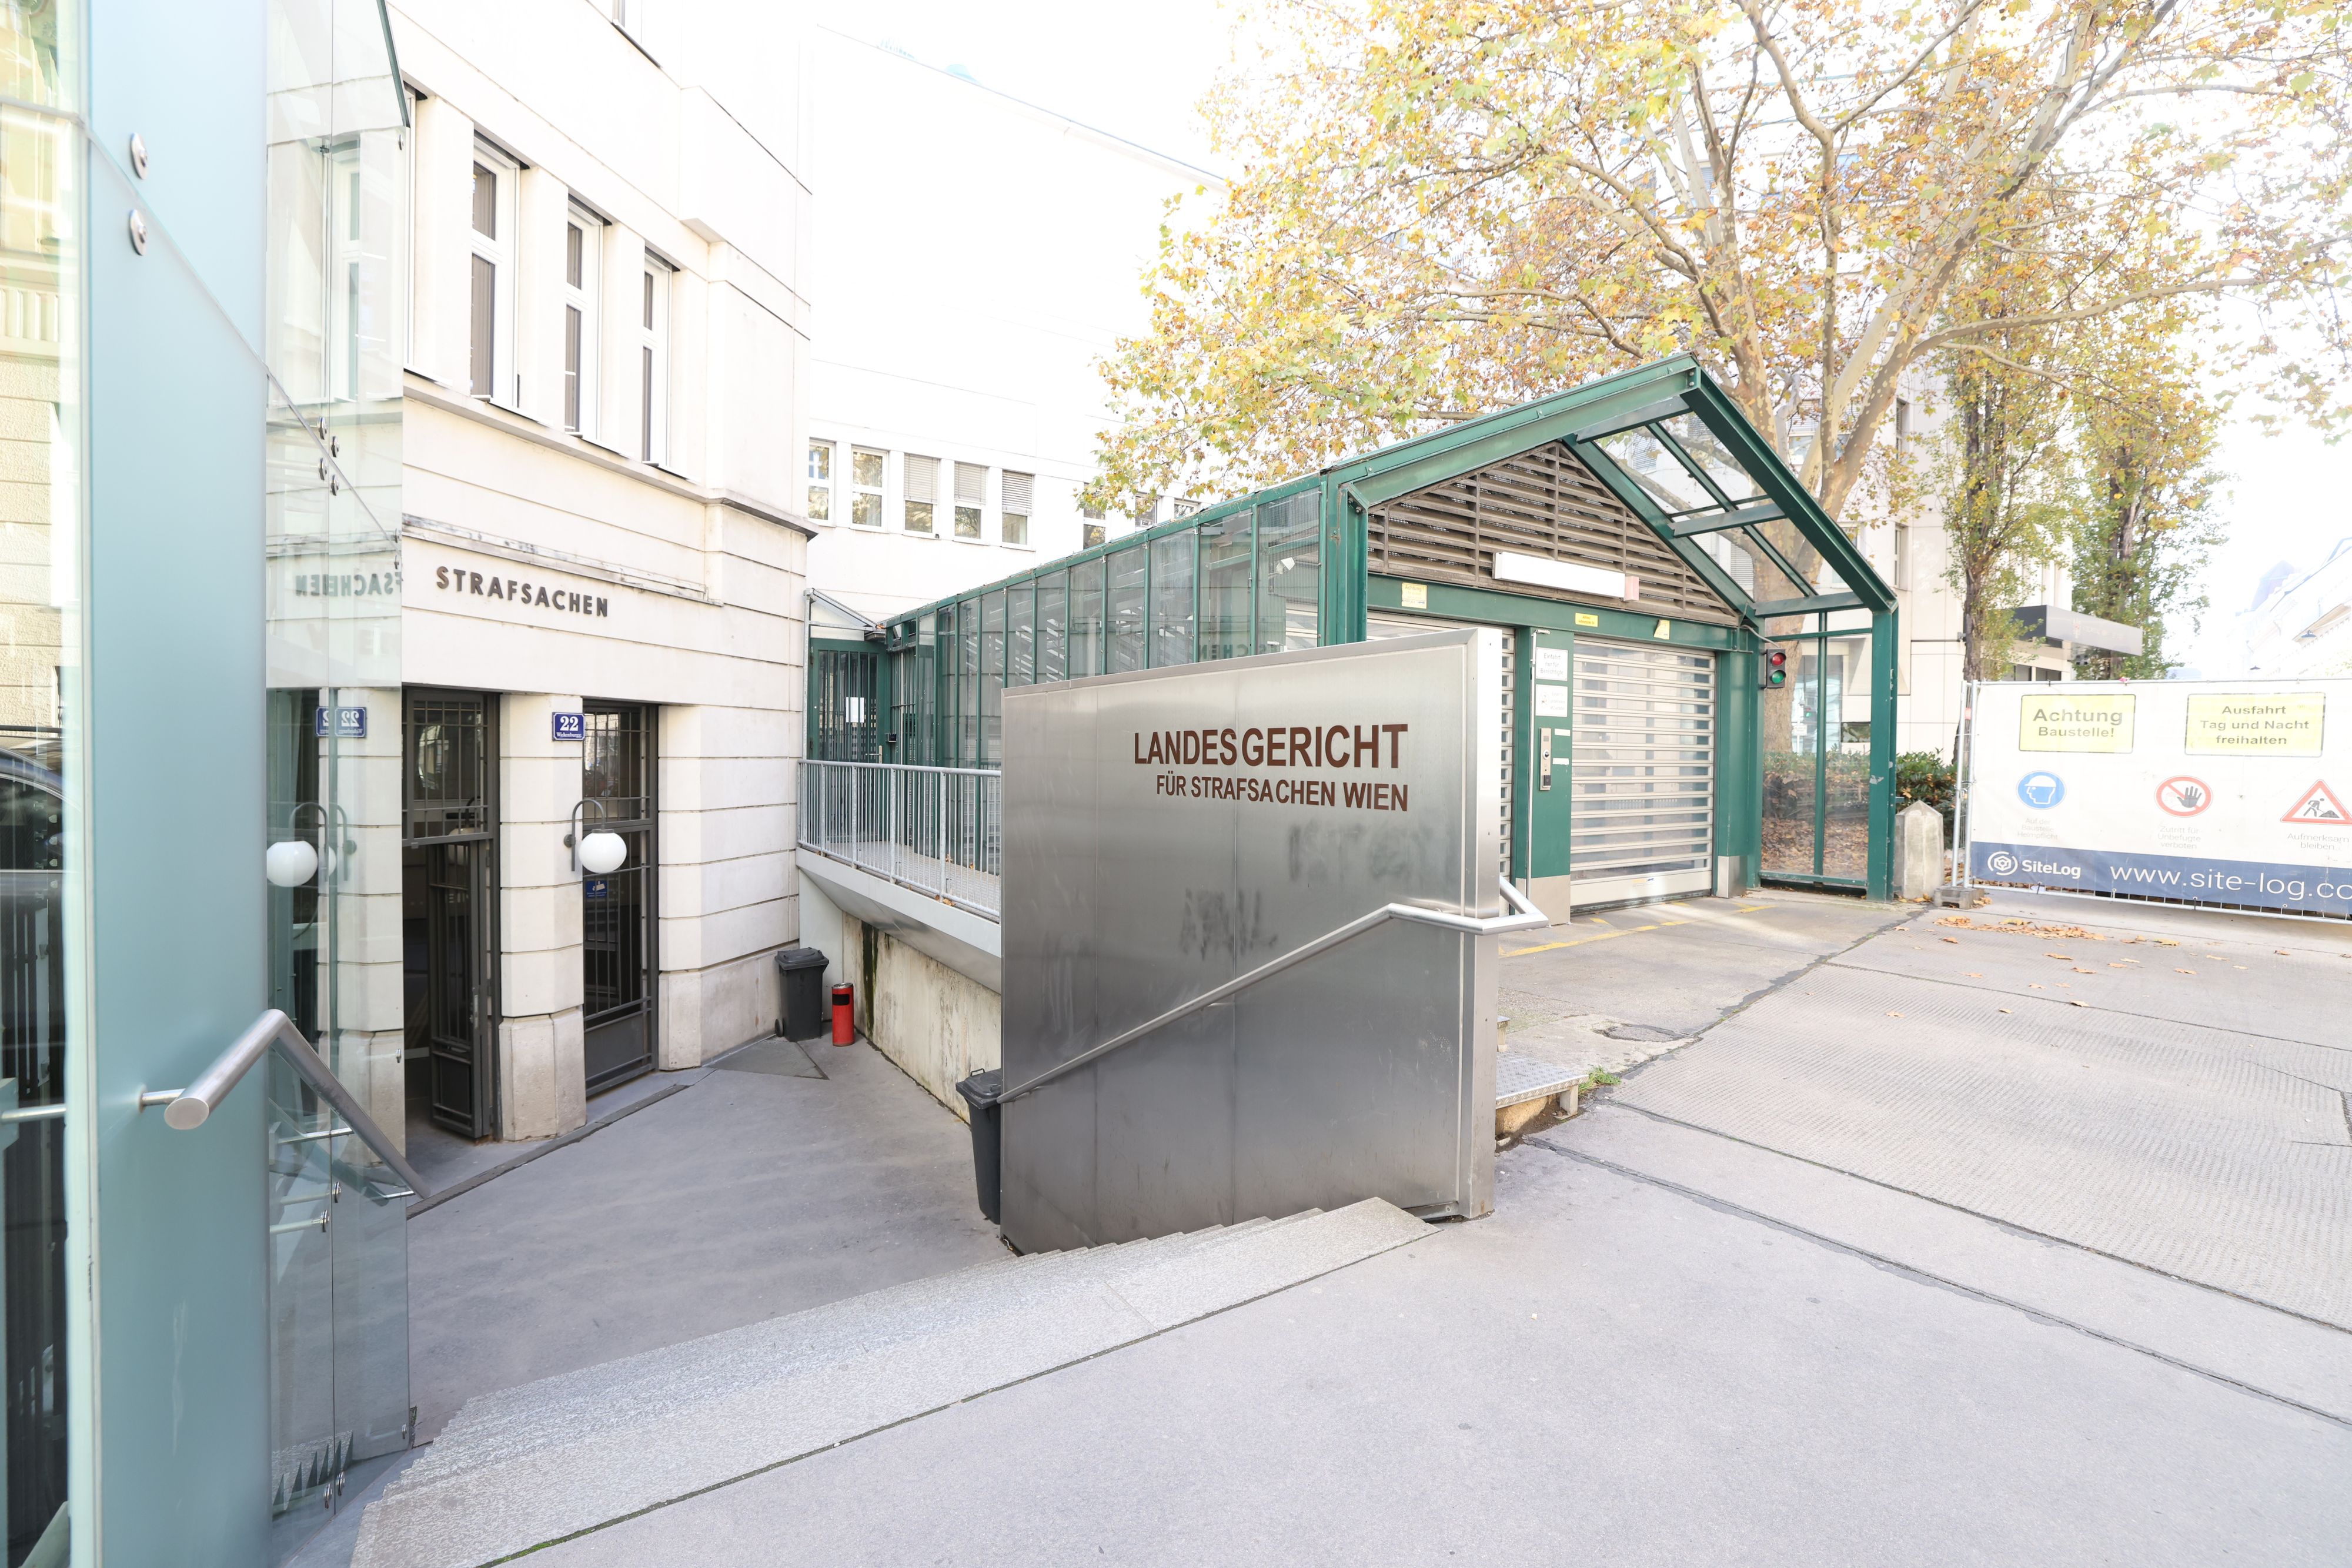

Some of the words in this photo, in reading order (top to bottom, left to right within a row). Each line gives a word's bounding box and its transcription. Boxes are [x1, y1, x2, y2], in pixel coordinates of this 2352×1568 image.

[436, 566, 609, 617] STRAFSACHEN
[2222, 706, 2286, 714] Ausfahrt
[560, 716, 579, 731] 22
[2033, 708, 2123, 726] Achtung
[2039, 727, 2114, 737] Baustelle!
[2200, 720, 2226, 731] Tag
[2232, 721, 2259, 729] und
[2264, 721, 2309, 729] Nacht
[2216, 735, 2287, 744] freihalten
[1134, 724, 1408, 769] LANDESGERICHT
[1156, 770, 1187, 797] FÜR
[1191, 775, 1336, 807] STRAFSACHEN
[1343, 782, 1408, 812] WIEN
[2158, 833, 2201, 842] Unbefugte
[2287, 833, 2349, 842] Aufmerksam
[2300, 841, 2334, 850] bleiben
[2022, 860, 2081, 879] SiteLog
[2110, 865, 2352, 901] www.site-log.co
